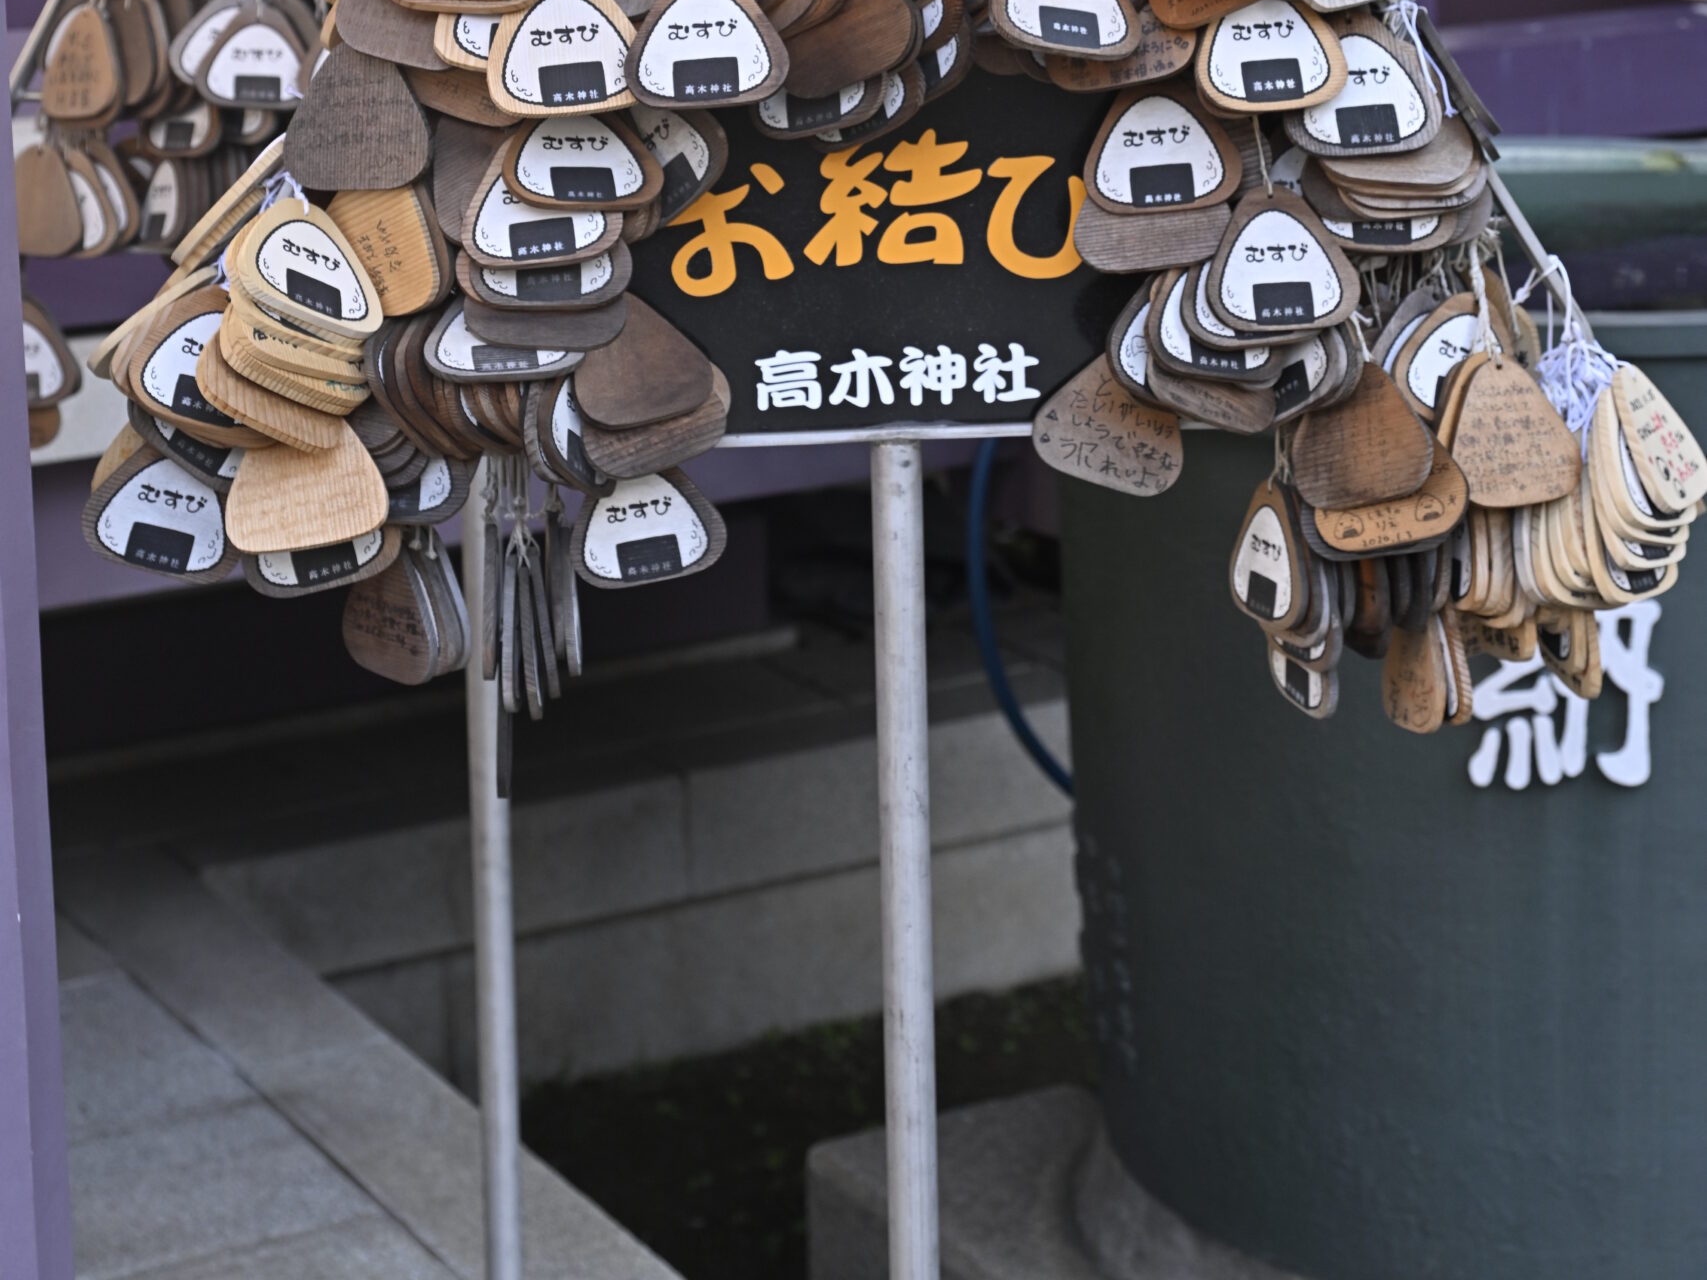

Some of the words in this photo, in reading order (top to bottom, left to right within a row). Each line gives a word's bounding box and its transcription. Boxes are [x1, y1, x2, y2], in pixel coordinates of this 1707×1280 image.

[530, 23, 600, 47] むすび
[668, 18, 738, 41] むすび
[1232, 20, 1295, 42] むすび
[1252, 77, 1297, 92] 高木神社
[1348, 65, 1391, 86] すび
[552, 88, 600, 104] 高木神社
[685, 83, 733, 96] 高木神社
[541, 133, 609, 153] むすび
[1122, 124, 1191, 149] むすび
[282, 237, 341, 272] むすび
[517, 241, 565, 257] 高木神社
[1245, 242, 1309, 265] むすび
[1261, 306, 1305, 319] 高木神社
[754, 342, 1042, 412] 高木神社
[137, 482, 209, 514] むすび
[606, 496, 673, 524] むすび
[134, 548, 181, 570] 高木神社
